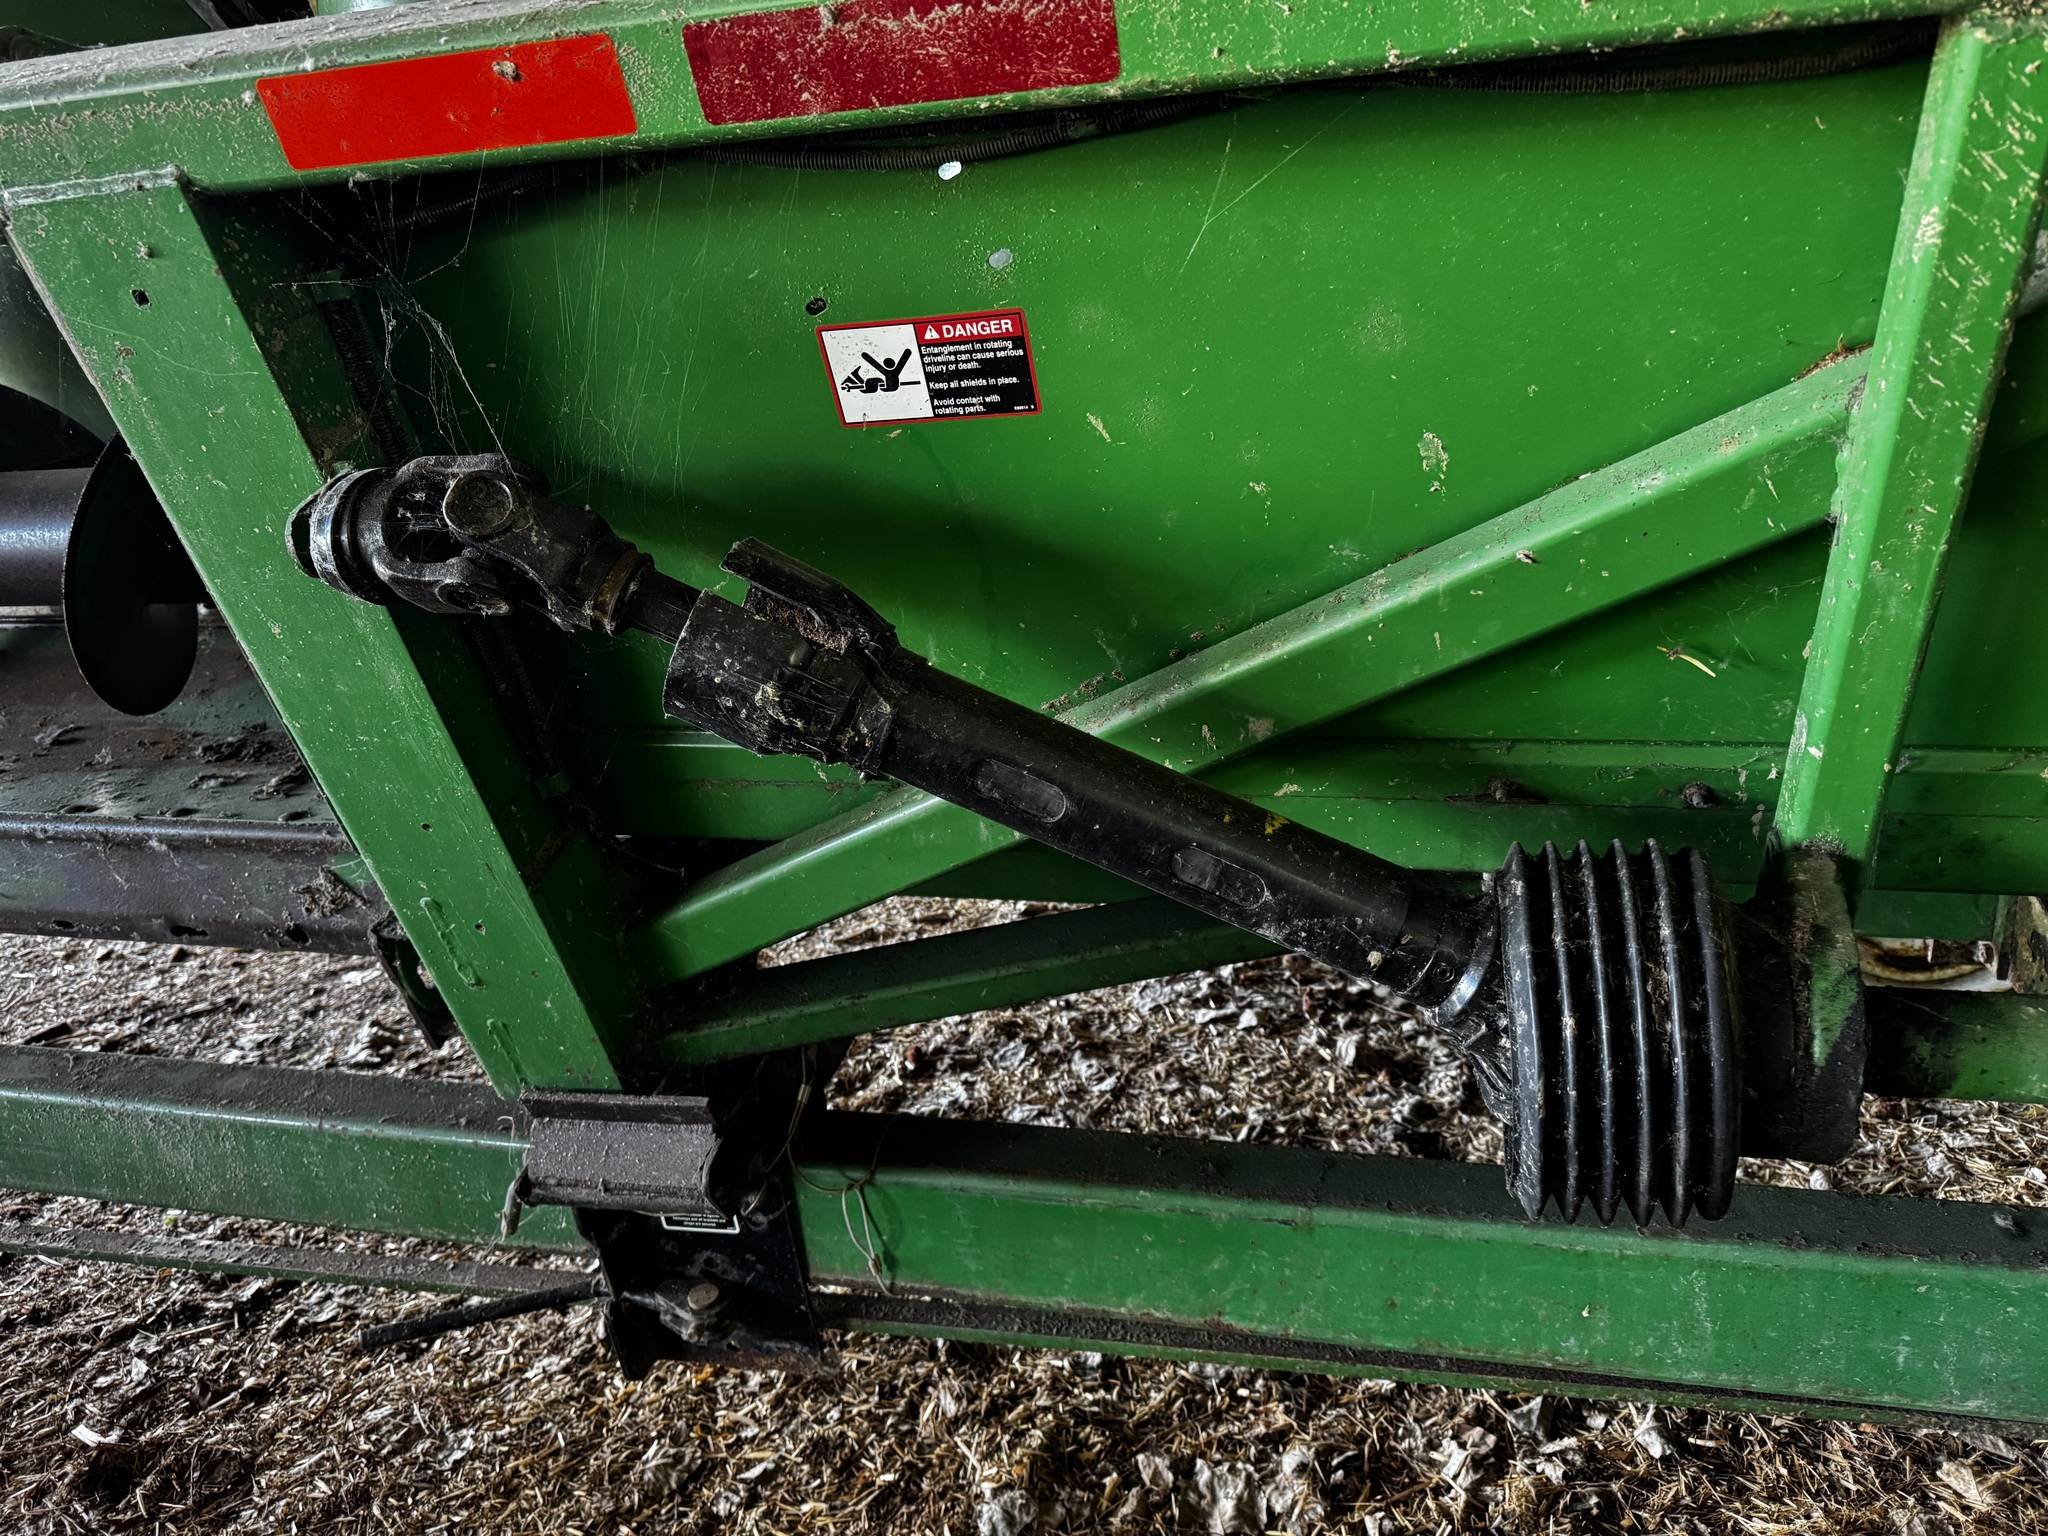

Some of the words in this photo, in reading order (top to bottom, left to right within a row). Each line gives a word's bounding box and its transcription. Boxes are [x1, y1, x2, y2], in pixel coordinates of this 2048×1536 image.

[942, 319, 1013, 338] DANGER
[921, 343, 973, 355] Entanglement
[983, 340, 1013, 350] rotating
[923, 354, 956, 364] driveline
[972, 351, 995, 359] cause
[996, 348, 1024, 357] serious
[925, 363, 947, 373] injury
[958, 361, 982, 370] death.
[929, 381, 949, 390] Keep
[949, 380, 959, 388] all
[960, 378, 987, 387] shields
[988, 377, 996, 385] in
[997, 376, 1020, 386] place.
[933, 397, 954, 406] Avoid
[956, 395, 984, 405] contact
[985, 394, 1001, 403] with
[935, 405, 964, 415] rotating
[965, 405, 987, 415] parts.
